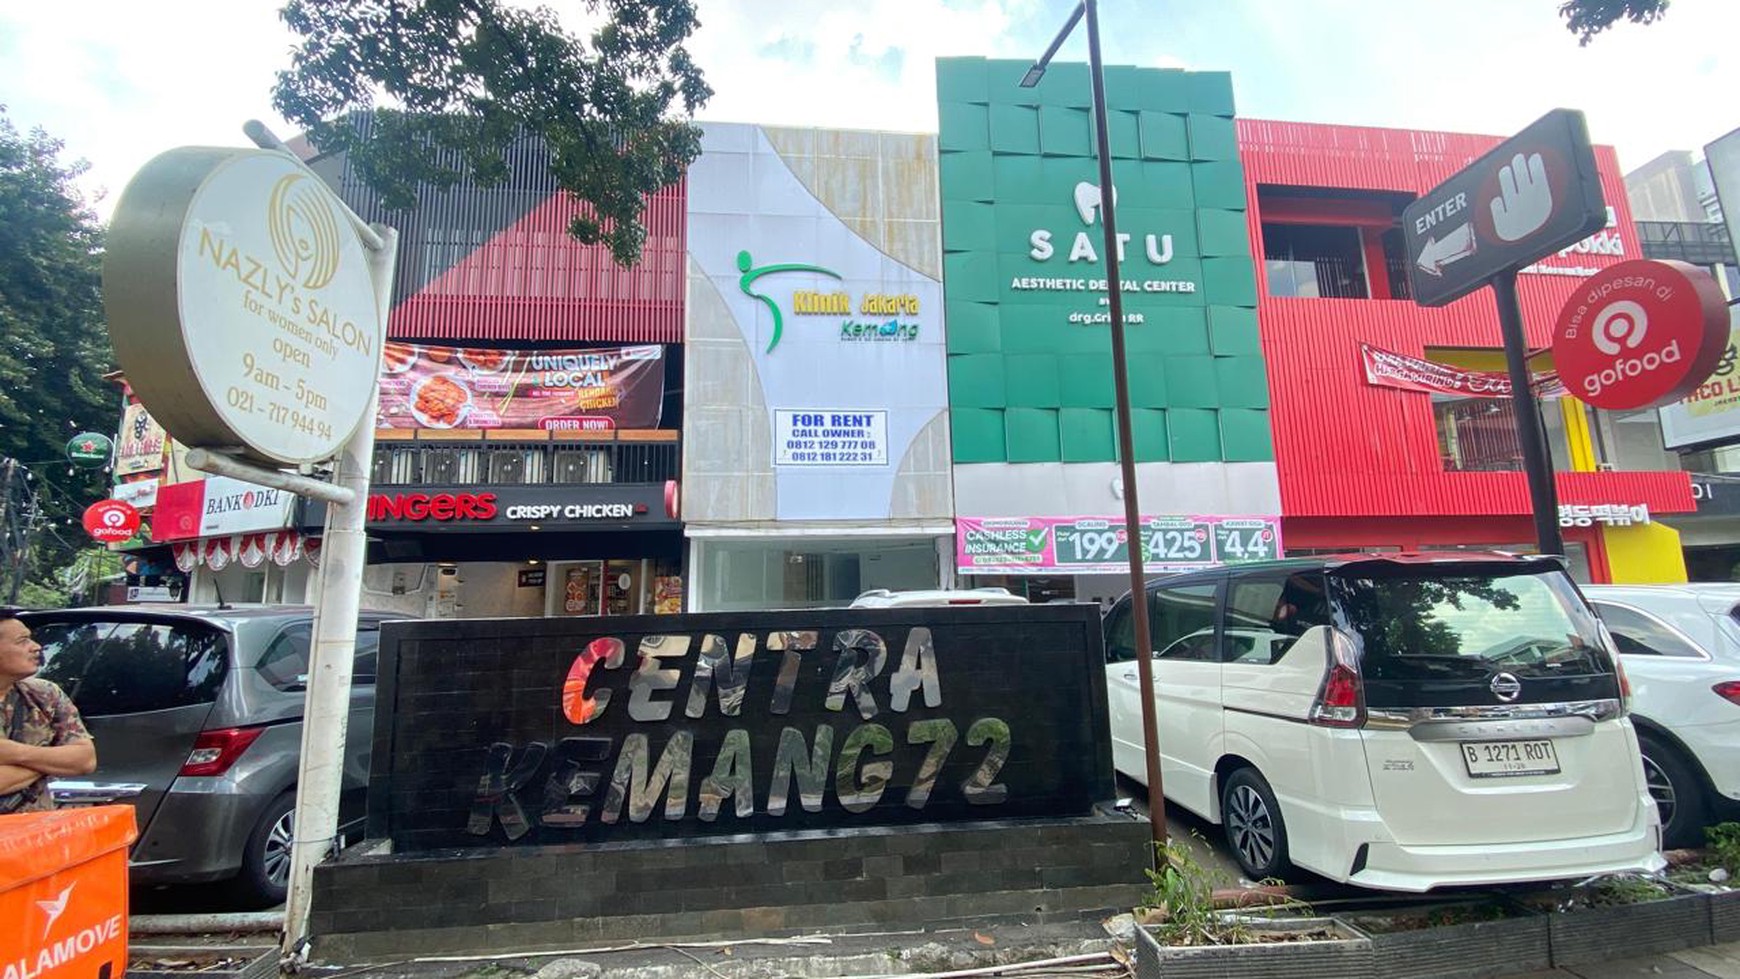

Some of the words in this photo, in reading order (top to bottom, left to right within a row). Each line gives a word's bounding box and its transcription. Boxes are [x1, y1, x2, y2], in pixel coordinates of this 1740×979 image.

[1415, 192, 1467, 234] ENTER
[200, 227, 302, 315] NAZLY's
[307, 299, 372, 357] SALON
[1012, 277, 1085, 289] AESTHETIC
[1088, 279, 1141, 291] DETAL
[1143, 280, 1195, 292] CENTER
[1565, 304, 1588, 340] Bisa
[1587, 275, 1656, 304] dipesan
[244, 290, 265, 317] for
[268, 307, 314, 343] women
[314, 336, 341, 362] only
[273, 337, 311, 370] open
[530, 354, 617, 371] UNIQUELY
[543, 371, 606, 388] LOCAL
[1583, 339, 1681, 397] gofood
[242, 353, 281, 392] 9am
[294, 378, 328, 411] 5pm
[226, 385, 255, 414] 021
[268, 402, 289, 426] 717
[291, 408, 315, 436] 944
[792, 414, 824, 427] FOR
[831, 414, 874, 427] RENT
[545, 420, 577, 430] ORDER
[582, 420, 609, 430] NOW!
[792, 429, 820, 438] CALL
[822, 429, 865, 438] OWNER
[786, 440, 816, 450] 0812
[818, 440, 838, 450] 129
[840, 440, 858, 450] 777
[860, 440, 876, 450] 08
[792, 452, 818, 462] 0812
[839, 452, 859, 462] 222
[860, 452, 873, 462] 31
[206, 498, 243, 515] BANK
[255, 489, 280, 507] DKI
[506, 505, 561, 519] CRISPY
[567, 504, 633, 518] CHICKEN
[965, 542, 1027, 554] INSURANCE
[966, 529, 1027, 541] CASHLESS
[1069, 531, 1119, 560] 199
[1149, 531, 1201, 559] 425
[1224, 530, 1269, 559] 4,4
[562, 626, 943, 726] CENTRA
[1466, 746, 1478, 763] B
[1484, 744, 1521, 762] 1271
[1524, 742, 1551, 760] ROT
[2, 914, 121, 979] ALAMOVE
